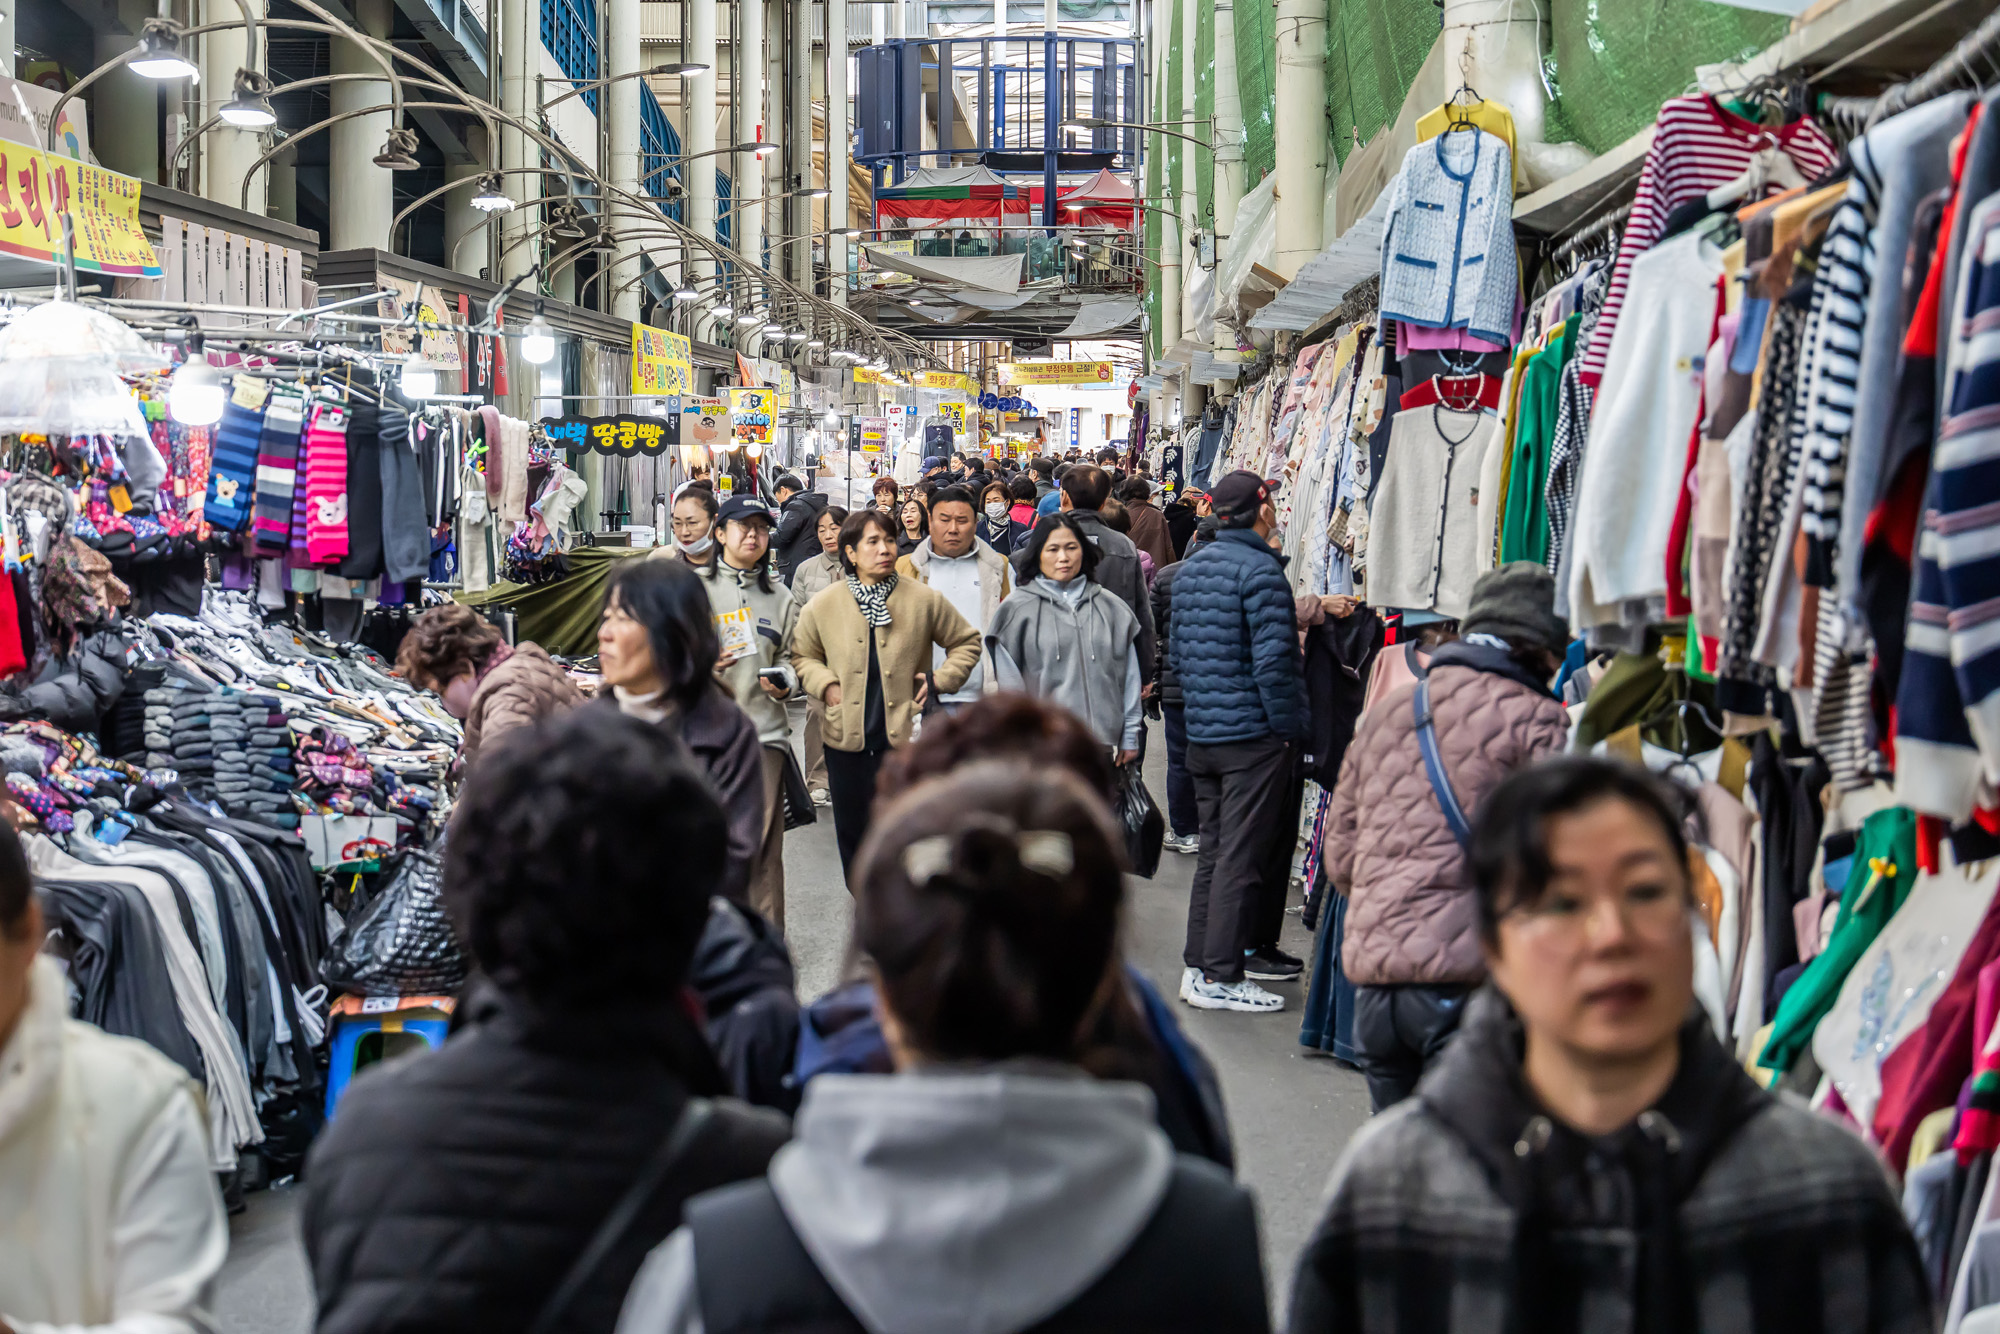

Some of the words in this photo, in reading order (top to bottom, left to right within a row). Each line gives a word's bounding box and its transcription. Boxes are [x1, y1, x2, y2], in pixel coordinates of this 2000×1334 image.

[108, 175, 127, 264] 콩국수
[123, 180, 146, 264] 칼국수
[1046, 364, 1074, 373] 부정유통
[1076, 364, 1095, 372] 근절!!
[684, 406, 701, 415] 새벽
[702, 405, 728, 416] 땅콩빵
[545, 422, 587, 446] 새벽
[592, 421, 665, 449] 땅콩빵
